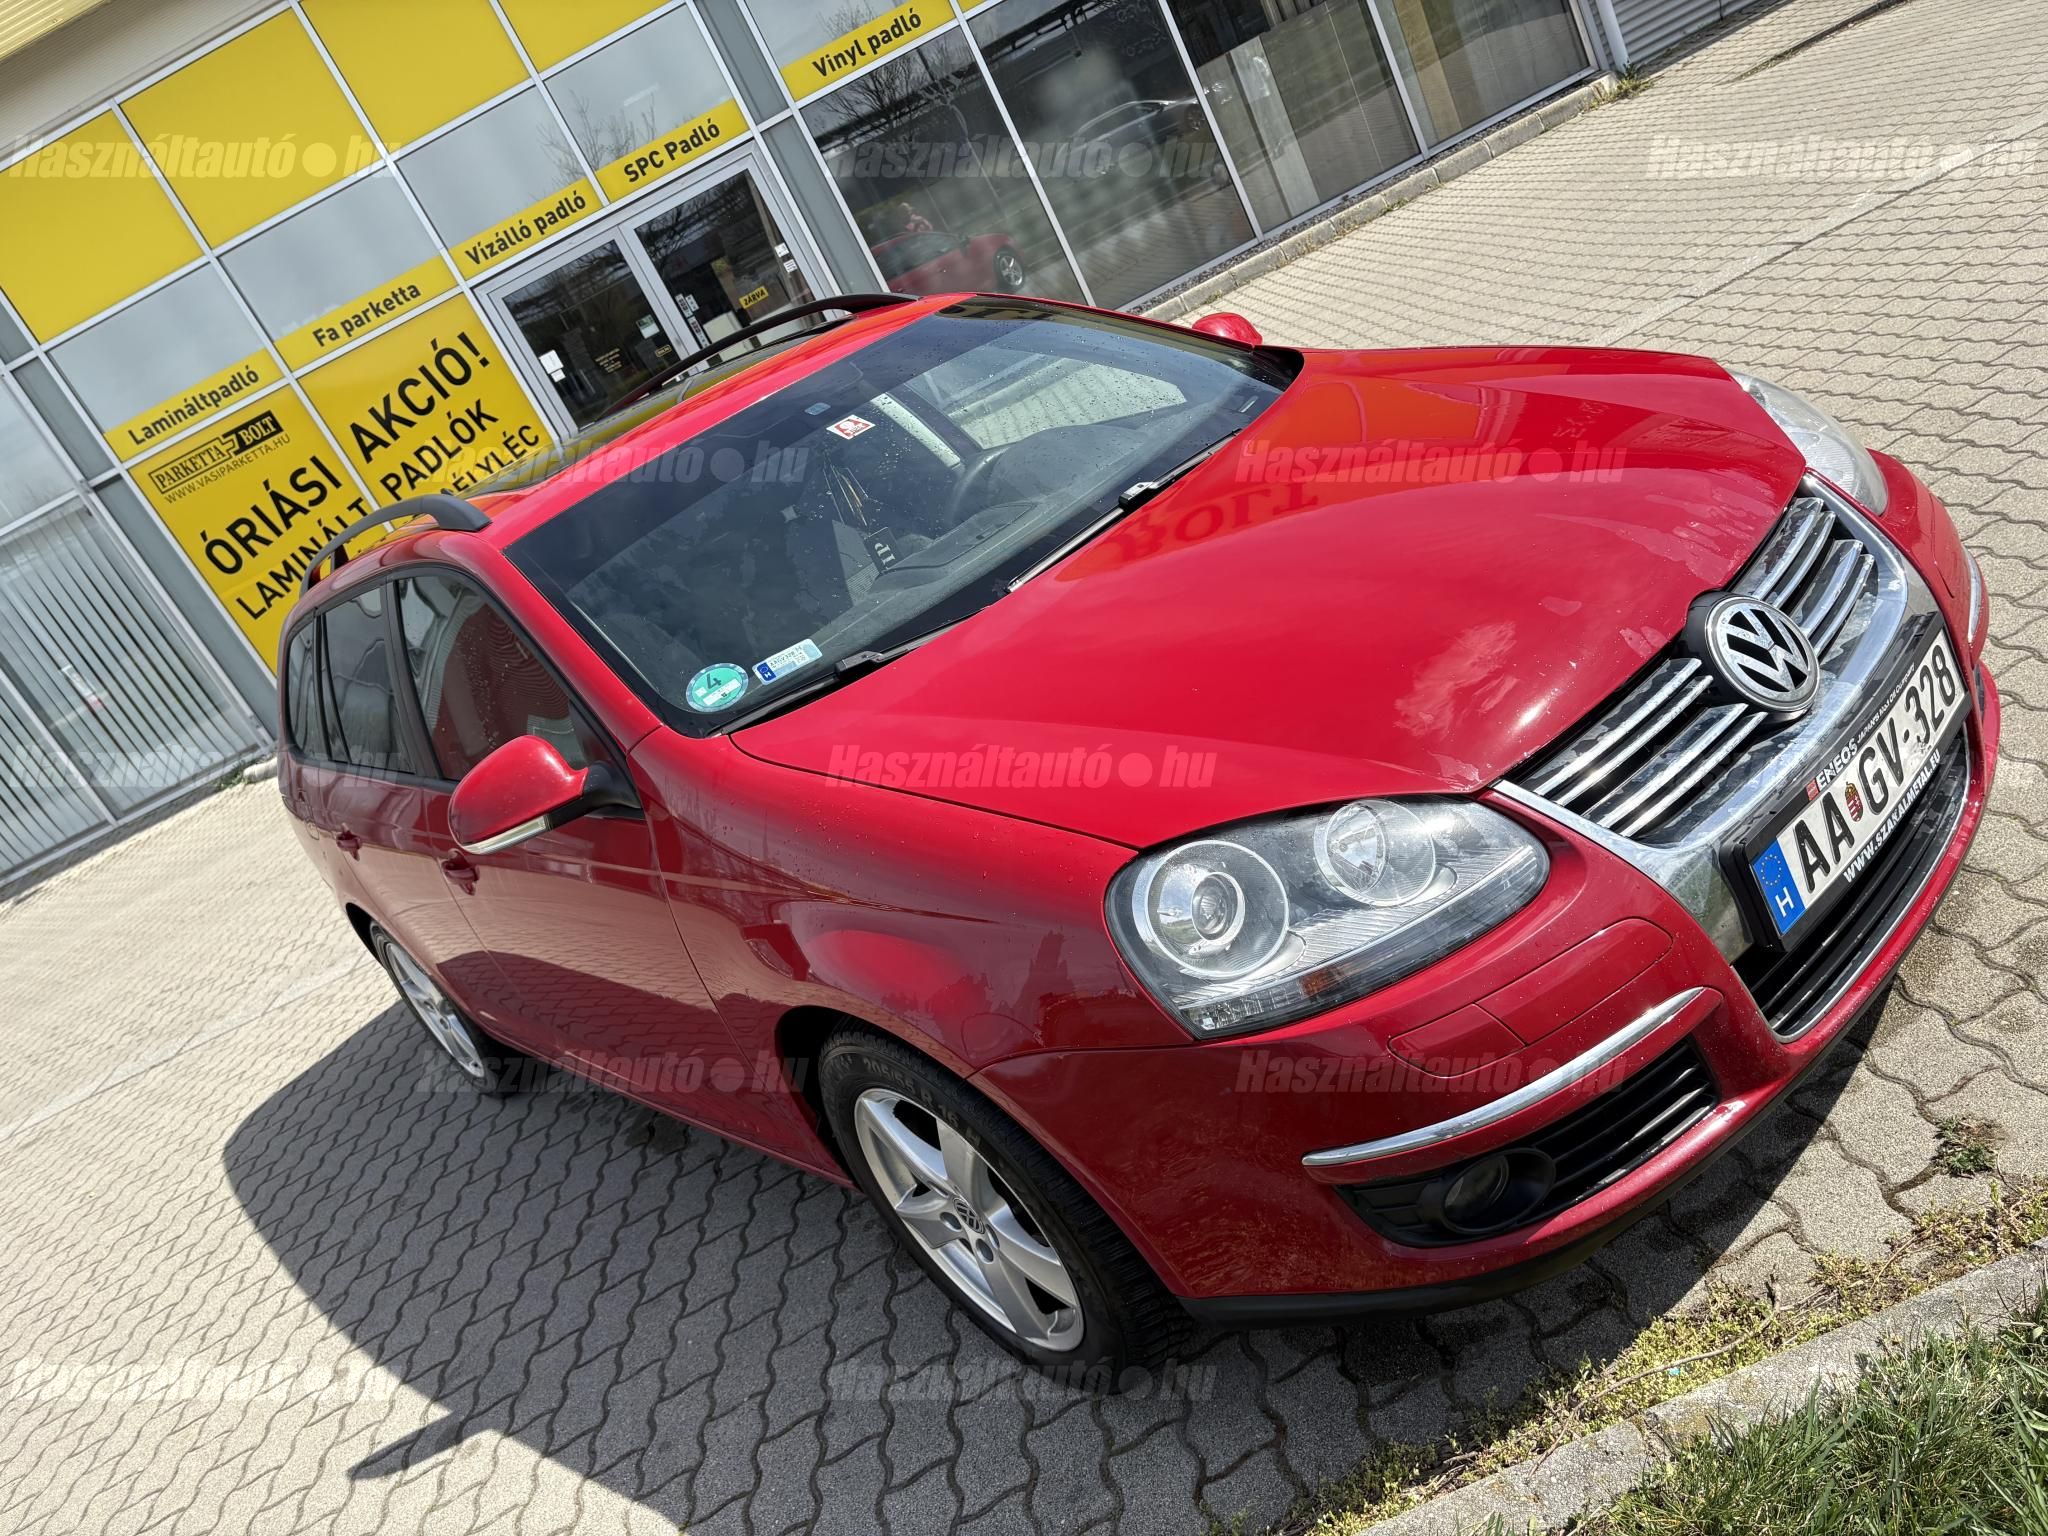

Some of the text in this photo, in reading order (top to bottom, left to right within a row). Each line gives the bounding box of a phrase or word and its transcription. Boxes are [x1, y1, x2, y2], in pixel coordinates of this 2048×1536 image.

[812, 9, 922, 78] Vinyl padló
[623, 117, 721, 183] SPC Padló
[465, 190, 586, 267] Vízálló padló
[312, 281, 421, 349] Fa parketta
[128, 364, 260, 447] Lamináltpadló
[153, 414, 277, 492] PARKETTA BOLT
[164, 432, 292, 505] WWW.VASIPARKETTA.HU
[202, 332, 489, 574] ÓRIÁSI AKCIÓ!
[380, 399, 499, 501] PADLÓK
[874, 543, 896, 570] IP
[706, 673, 722, 689] 4
[1775, 643, 1957, 918] H AA GV-328
[1815, 738, 1858, 790] ENEOS
[1843, 750, 1942, 883] WWW.SZAKALMETAL.EU
